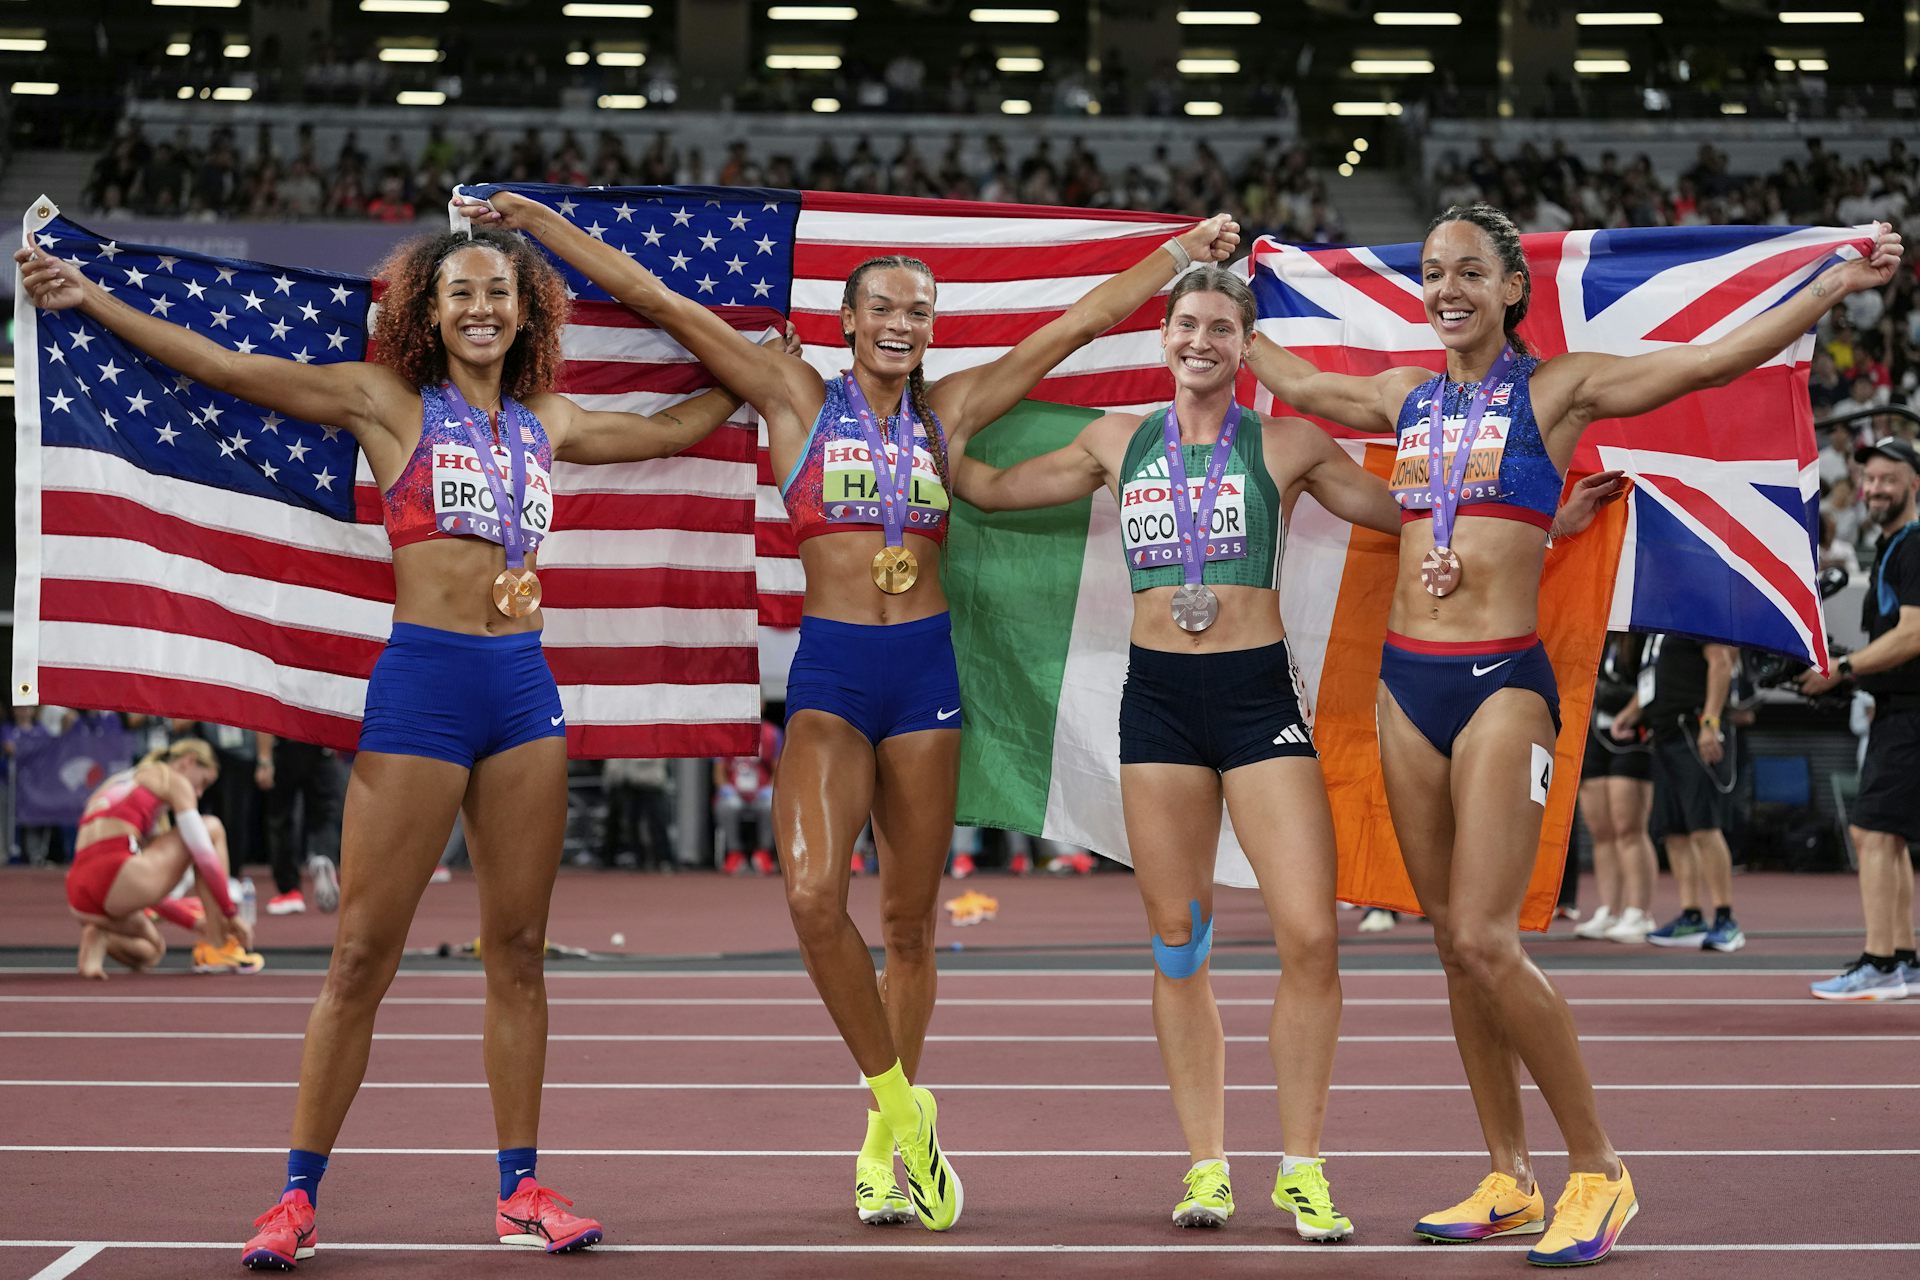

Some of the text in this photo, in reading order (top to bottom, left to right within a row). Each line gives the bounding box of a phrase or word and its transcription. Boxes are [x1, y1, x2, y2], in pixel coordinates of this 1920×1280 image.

[1400, 425, 1504, 451] HONA
[436, 453, 550, 495] HONA
[441, 481, 547, 530] BROKS
[1475, 486, 1497, 498] 25
[923, 513, 941, 524] 25
[1128, 506, 1240, 543] O'COOR
[1220, 542, 1242, 554] 25
[1540, 762, 1549, 800] 4
